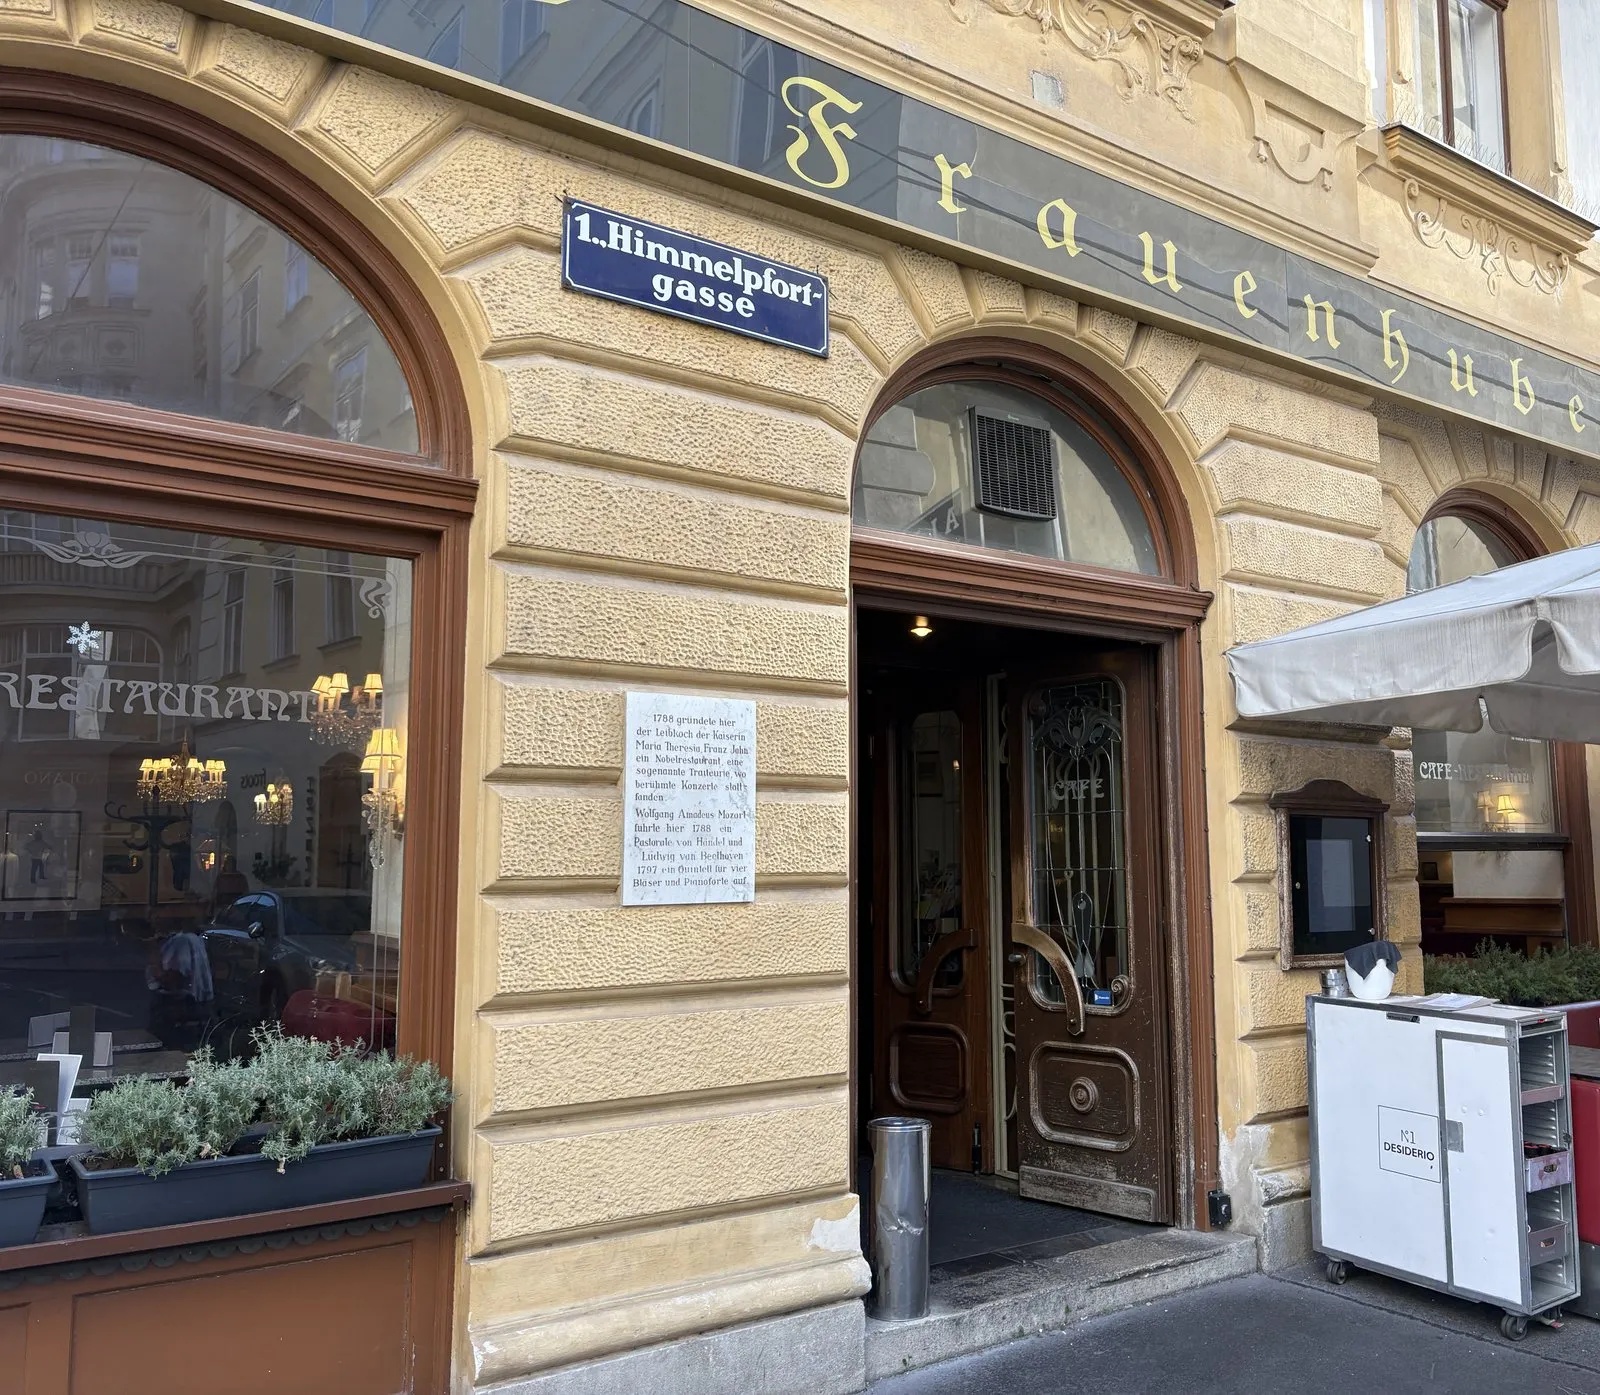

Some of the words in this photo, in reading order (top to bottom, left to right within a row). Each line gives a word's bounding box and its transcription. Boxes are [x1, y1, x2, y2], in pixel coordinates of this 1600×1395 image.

[652, 273, 755, 318] gasse
[0, 672, 318, 722] RESTAURANT
[653, 714, 674, 723] 1788
[719, 718, 736, 727] hier
[636, 727, 652, 736] der
[656, 728, 693, 739] Leibkoch
[696, 731, 710, 740] der
[713, 730, 746, 741] Kaiserin
[635, 740, 661, 751] Maria
[703, 743, 727, 754] Franz
[636, 755, 649, 763] ein
[727, 759, 744, 767] eine
[636, 767, 686, 778] sogenannte
[735, 771, 747, 779] wo
[635, 779, 676, 790] berühmte
[682, 780, 718, 791] Konzerte
[1053, 778, 1105, 800] CAFE
[635, 808, 674, 821] Wolfgang
[678, 808, 714, 820] Amadeus
[718, 809, 746, 820] Mozart
[666, 823, 685, 833] hier
[692, 824, 712, 833] 1788
[720, 824, 732, 833] ein
[634, 837, 673, 847] Pastorale
[676, 839, 692, 847] von
[728, 837, 743, 847] und
[642, 851, 675, 862] Ludwig
[700, 850, 744, 861] Beethoven
[637, 866, 658, 874] 1797
[662, 866, 675, 874] ein
[678, 865, 712, 874] Quintett
[731, 865, 748, 873] vier
[665, 878, 680, 887] und
[684, 877, 729, 886] Pianoforte
[1383, 1141, 1435, 1162] DESIDERIO
